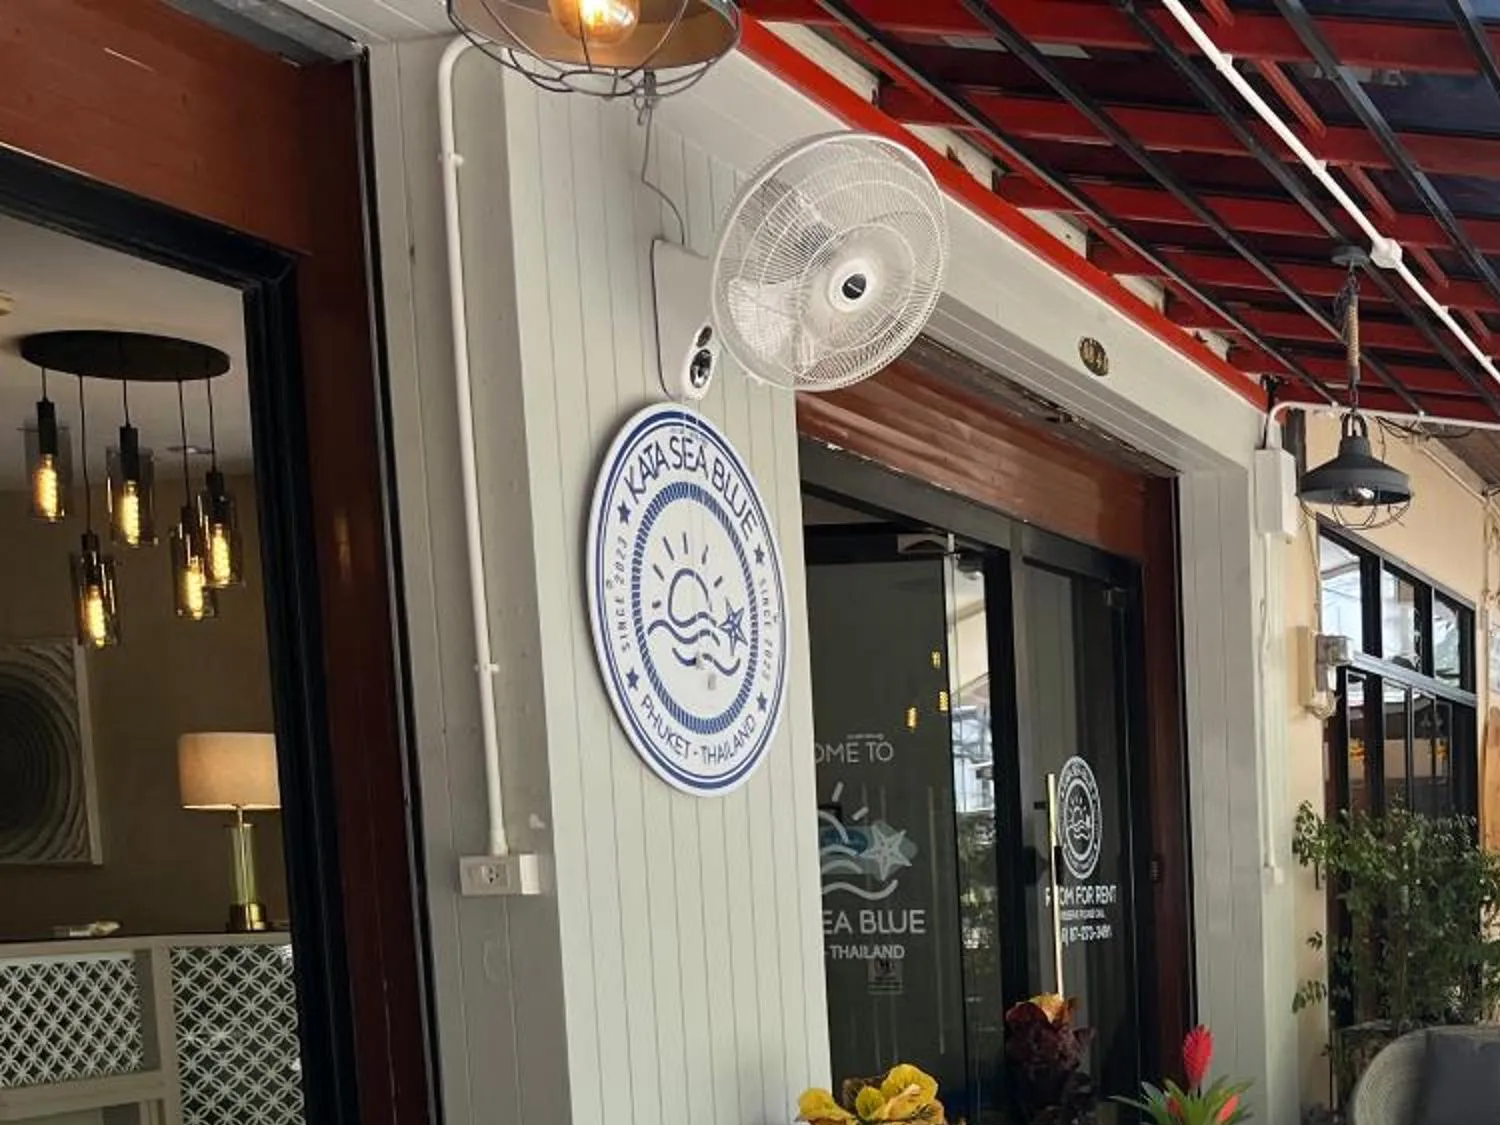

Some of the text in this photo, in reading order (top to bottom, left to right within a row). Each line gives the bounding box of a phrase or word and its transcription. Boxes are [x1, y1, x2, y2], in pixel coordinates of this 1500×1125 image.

[624, 435, 758, 541] KATA SEA BLUE
[641, 694, 691, 759] PHUKET
[701, 714, 757, 765] THAILAND
[865, 741, 894, 762] TO
[1076, 885, 1095, 905] FOR
[860, 909, 926, 934] BLUE
[829, 944, 906, 959] THAILAND
